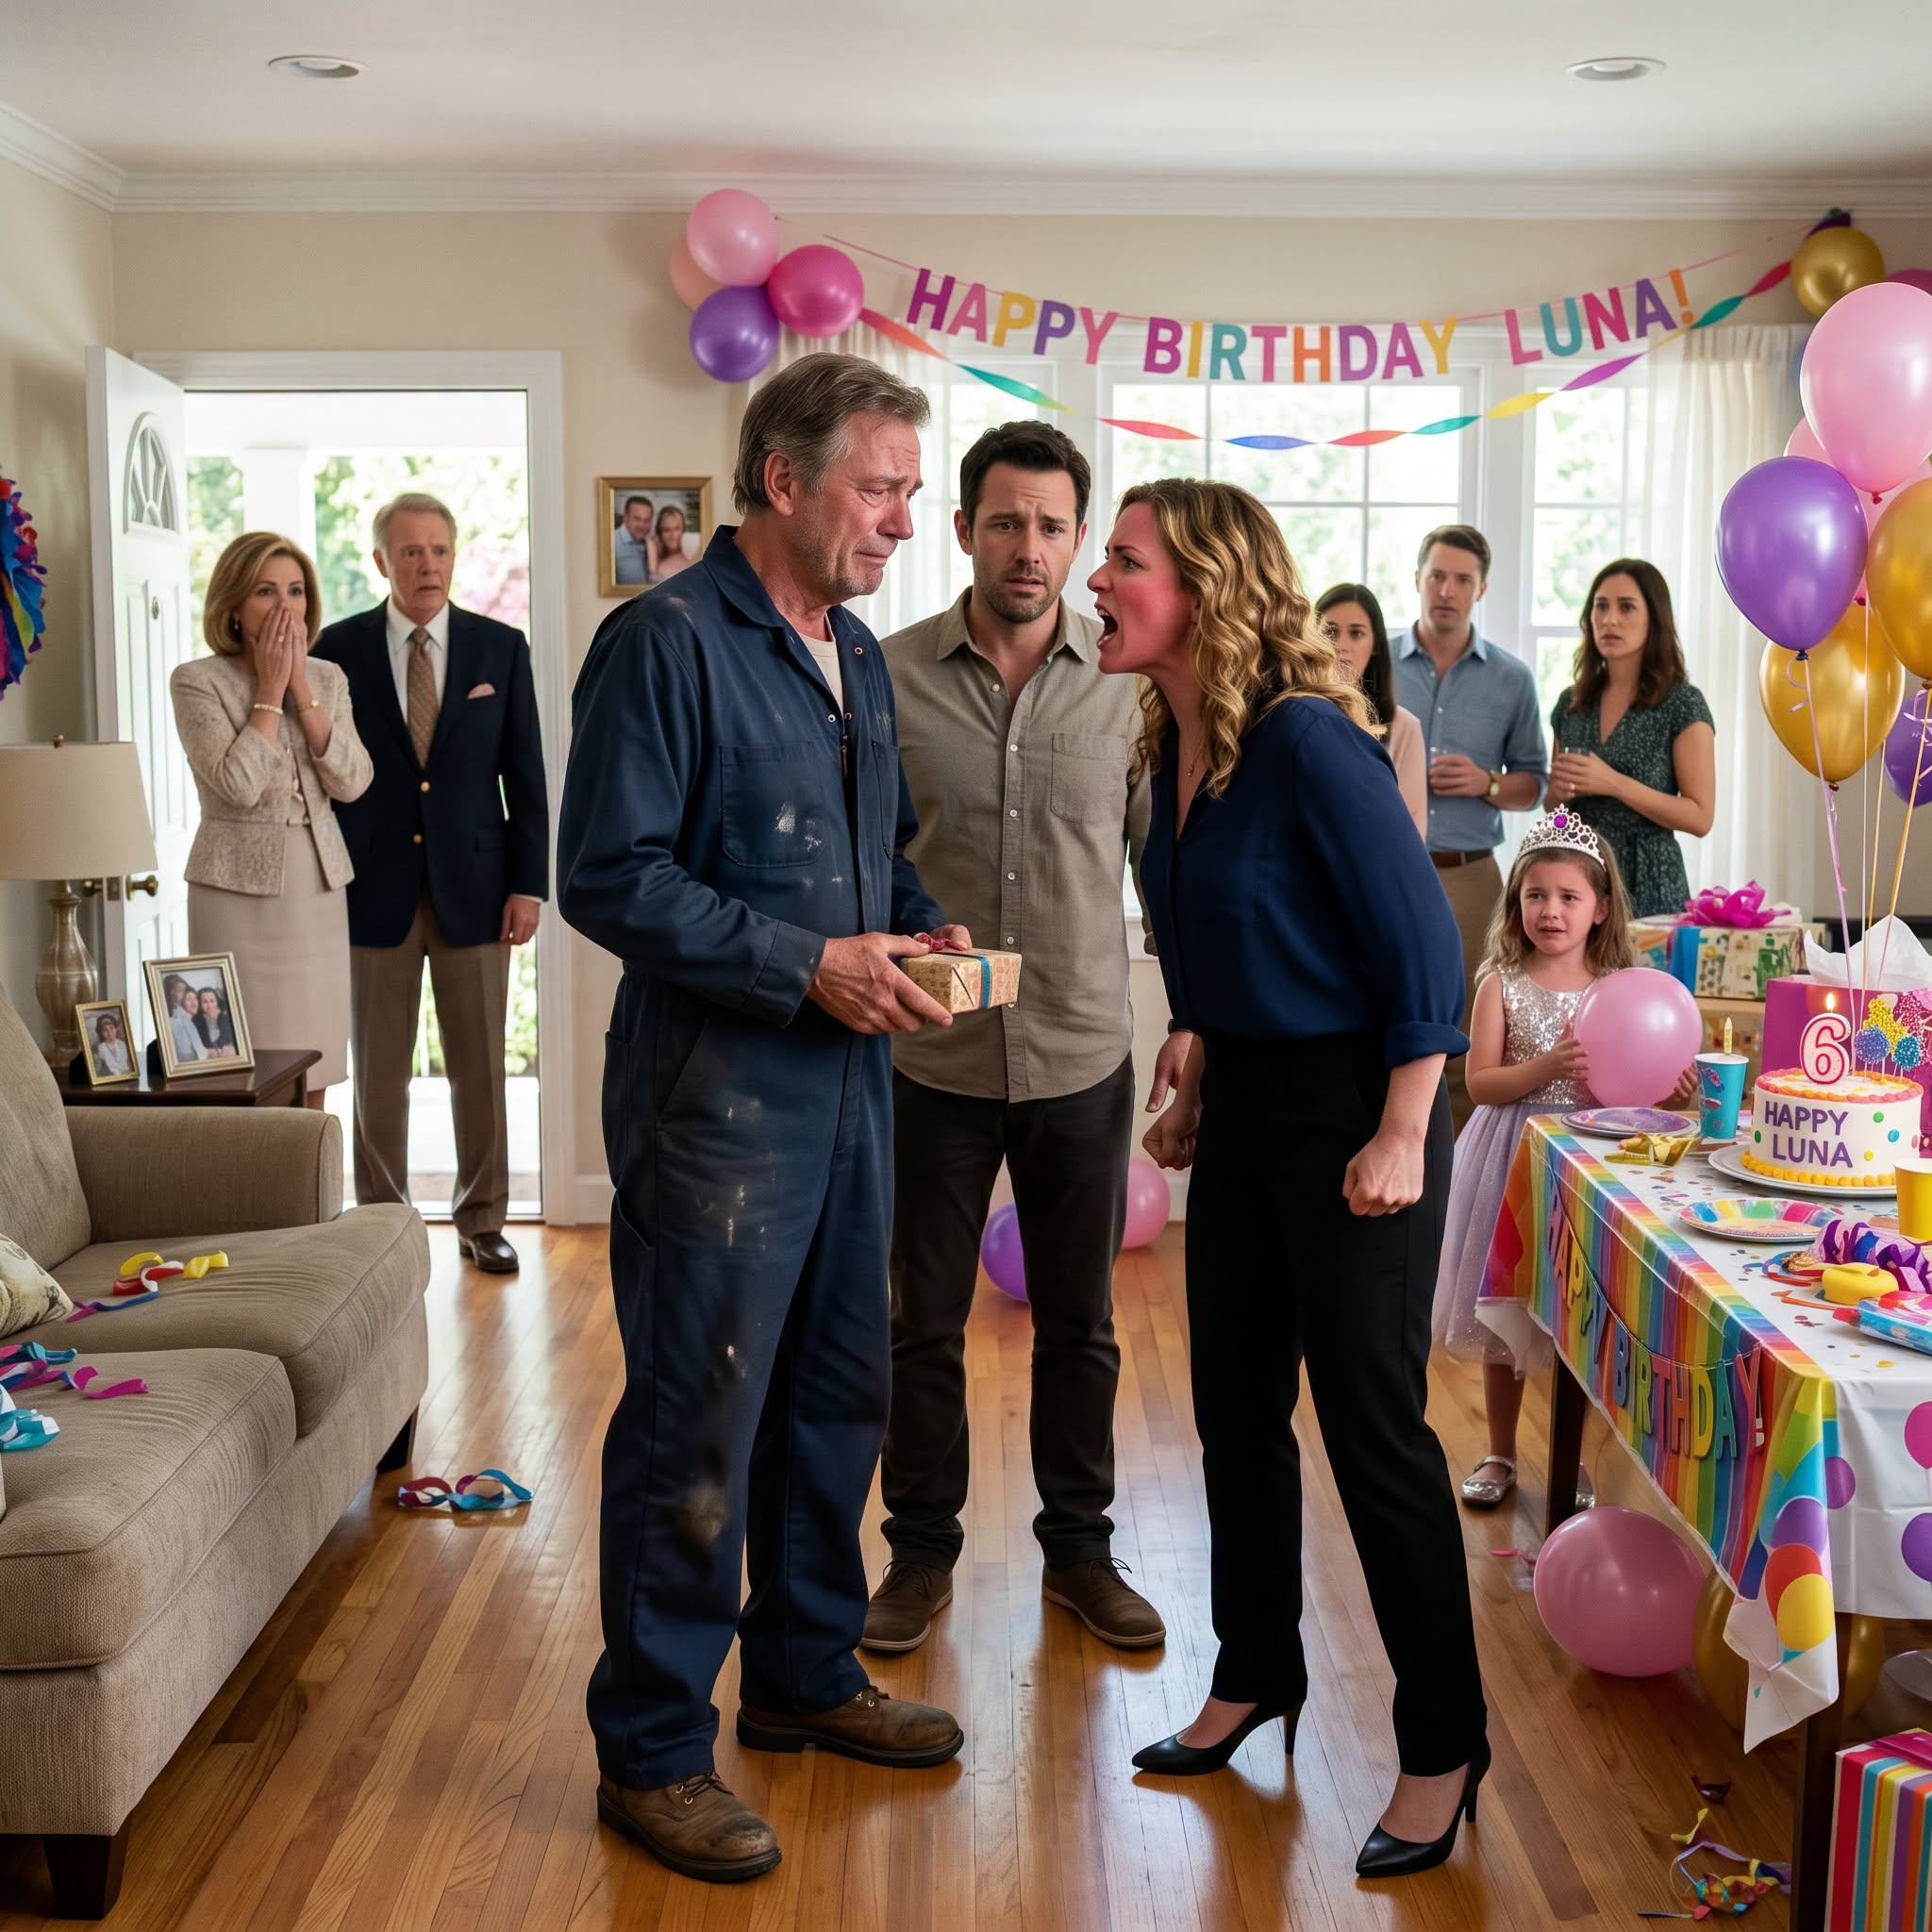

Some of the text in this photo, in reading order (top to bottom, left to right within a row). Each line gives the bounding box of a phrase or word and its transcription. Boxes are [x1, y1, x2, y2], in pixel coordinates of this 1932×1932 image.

[906, 267, 1694, 382] HAPPY BIRTHDAY LUNA!
[1800, 1013, 1851, 1085] 6
[1764, 1100, 1849, 1136] HAPPY
[1773, 1133, 1854, 1169] LUNA
[1547, 1175, 1610, 1364] HAPPY
